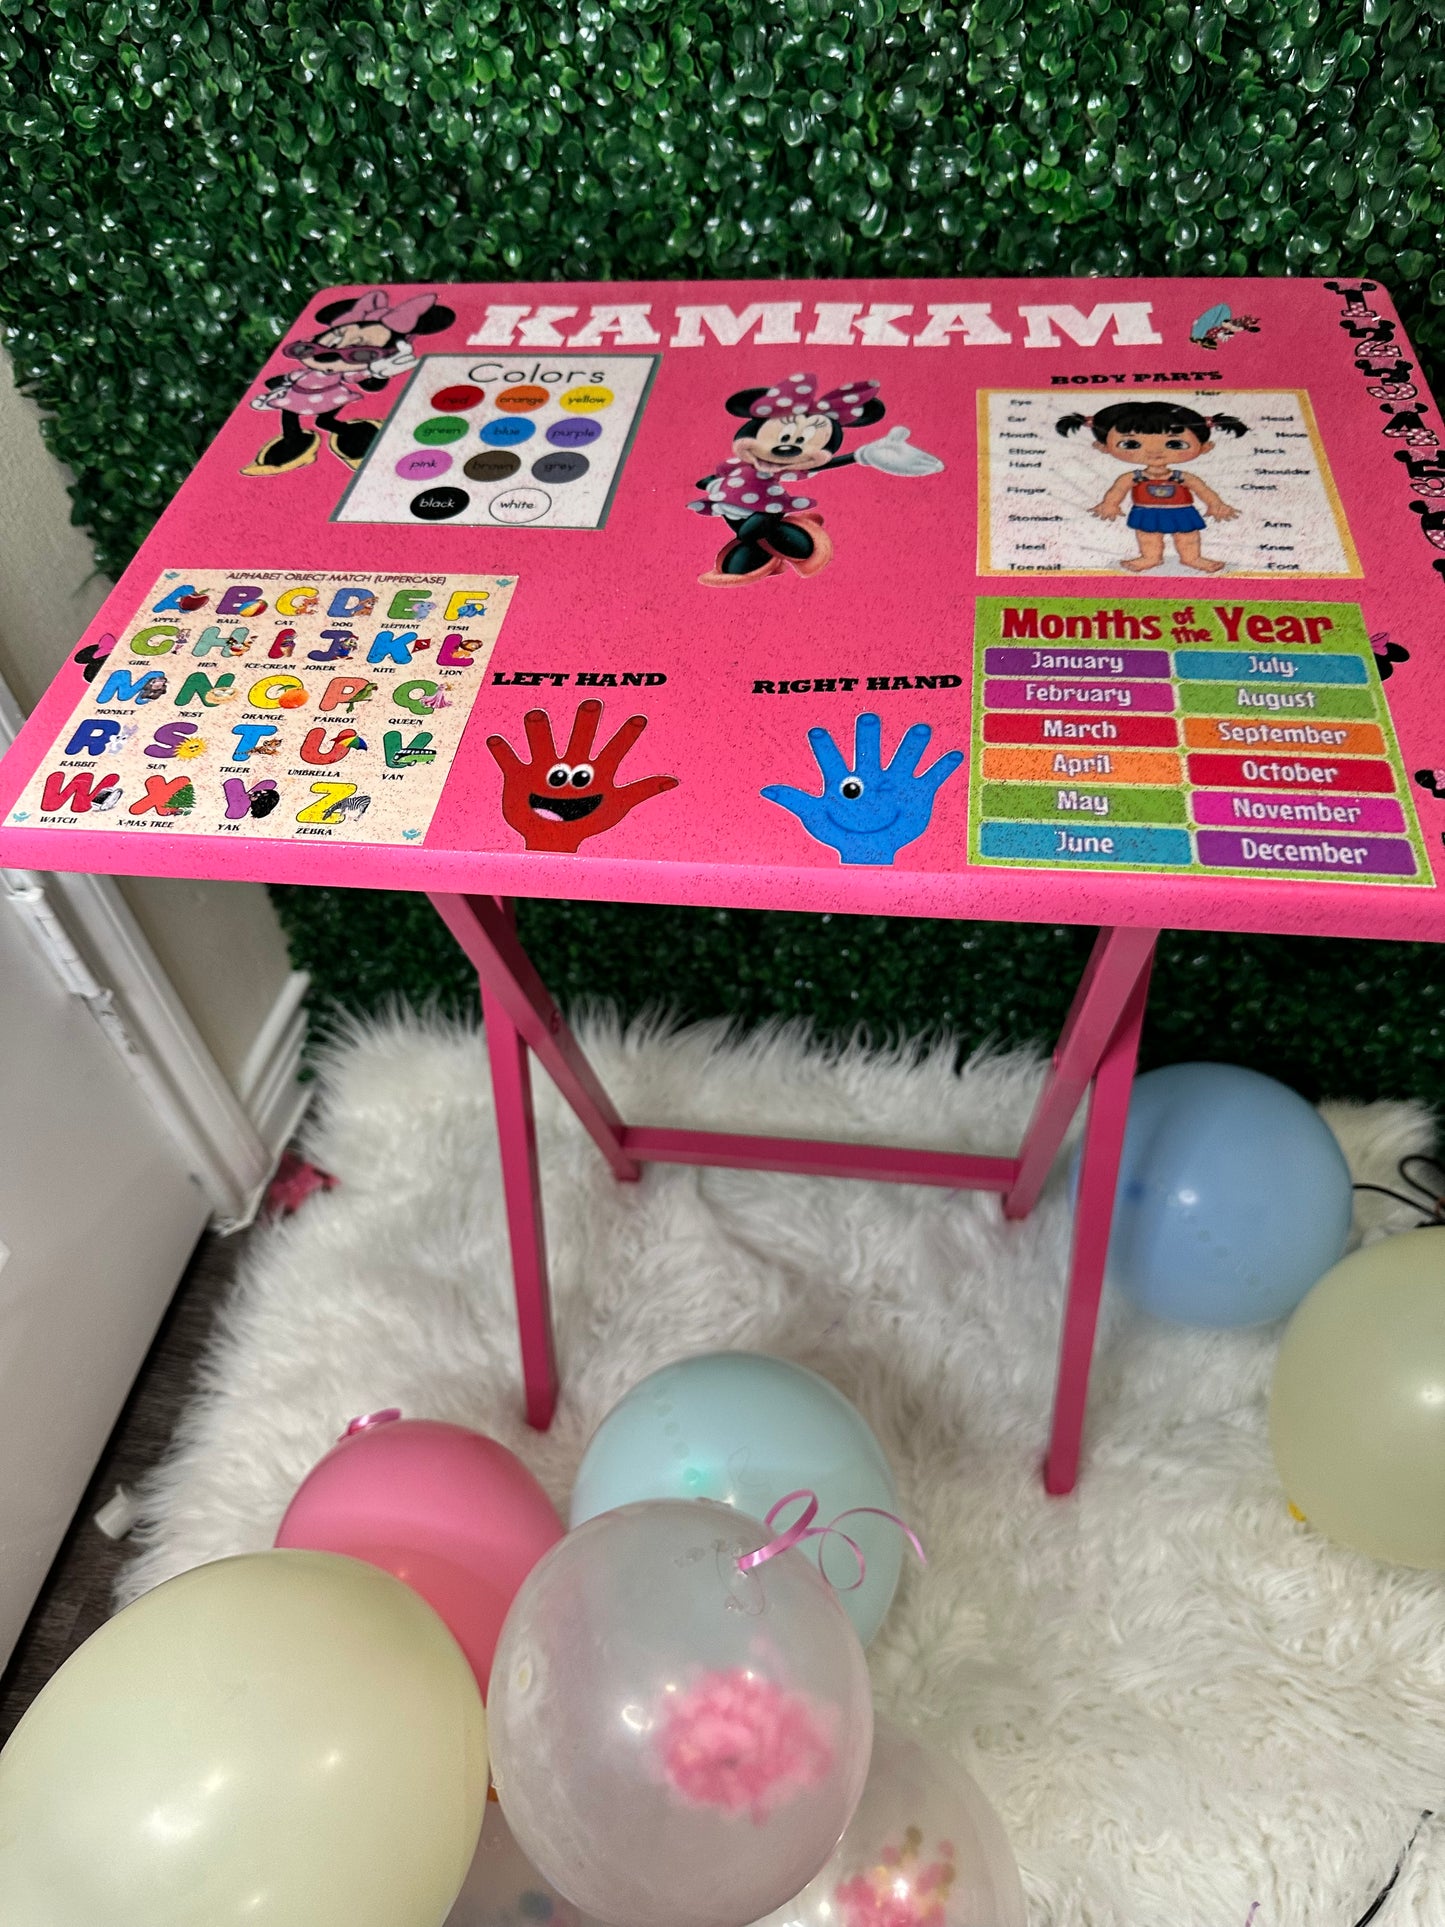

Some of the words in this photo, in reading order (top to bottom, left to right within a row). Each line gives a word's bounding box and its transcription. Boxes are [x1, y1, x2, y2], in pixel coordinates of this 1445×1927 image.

[466, 303, 1165, 348] KAMKAM
[1349, 327, 1402, 357] 2
[467, 362, 608, 385] Colors
[1050, 372, 1126, 386] BODY
[1132, 370, 1224, 384] PARTS
[1363, 367, 1418, 400] 3
[442, 395, 470, 405] red
[499, 396, 544, 407] orange
[567, 394, 607, 407] yellow
[422, 427, 461, 437] green
[492, 426, 521, 436] blue
[551, 428, 595, 440] purple
[1382, 411, 1440, 446] 4
[408, 460, 437, 470] pink
[472, 462, 514, 472] brown
[543, 462, 577, 474] grey
[1007, 486, 1047, 494] Finger
[419, 498, 456, 509] black
[500, 499, 535, 510] white
[226, 572, 281, 581] ALPHABET
[284, 573, 327, 581] OBJECT
[328, 574, 372, 582] MATCH
[374, 575, 446, 585] (UPPERCASE)
[153, 585, 196, 614] A
[216, 586, 264, 615] B
[275, 586, 319, 616] C
[327, 587, 375, 617] D
[388, 589, 432, 620] E
[443, 591, 490, 621] F
[1001, 607, 1161, 640] Months
[1171, 606, 1194, 625] of
[1218, 607, 1335, 643] Year
[130, 625, 181, 656] G
[191, 626, 249, 658] H
[268, 628, 296, 659] I
[307, 629, 356, 662] J
[1170, 626, 1213, 644] the
[367, 631, 418, 665] K
[436, 633, 475, 667] L
[244, 662, 297, 670] ICE-CREAM
[1030, 651, 1125, 674] January
[1248, 656, 1294, 677] July
[96, 669, 166, 705] M
[174, 671, 235, 707] N
[491, 672, 571, 687] LEFT
[574, 672, 668, 687] HAND
[751, 677, 860, 695] RIGHT
[864, 674, 963, 691] HAND
[247, 674, 305, 709] O
[319, 676, 371, 712] P
[392, 679, 439, 715] Q
[1025, 683, 1132, 706] February
[1237, 688, 1317, 710] August
[95, 708, 136, 716] MONKEY
[241, 713, 284, 721] ORANGE
[313, 716, 357, 724] PARROT
[388, 718, 424, 726] QUEEN
[65, 719, 121, 756] R
[144, 722, 198, 759] S
[1042, 719, 1117, 739] March
[1218, 721, 1348, 746] September
[231, 724, 278, 762] T
[300, 727, 357, 765] U
[383, 730, 433, 769] V
[59, 760, 98, 768] RABBIT
[219, 766, 251, 774] TIGER
[288, 769, 341, 778] UMBRELLA
[1052, 754, 1112, 775] April
[1242, 760, 1339, 783] October
[381, 773, 404, 781] VAN
[40, 771, 120, 813] W
[129, 774, 192, 816] X
[223, 777, 277, 820] Y
[296, 781, 358, 824] Z
[1056, 790, 1110, 816] May
[39, 816, 78, 824] WATCH
[1232, 798, 1361, 824] November
[116, 819, 148, 828] X-MAS
[149, 820, 175, 829] TREE
[216, 823, 241, 831] YAK
[295, 827, 333, 836] ZEBRA
[1054, 830, 1114, 854] June
[1241, 838, 1369, 865] December
